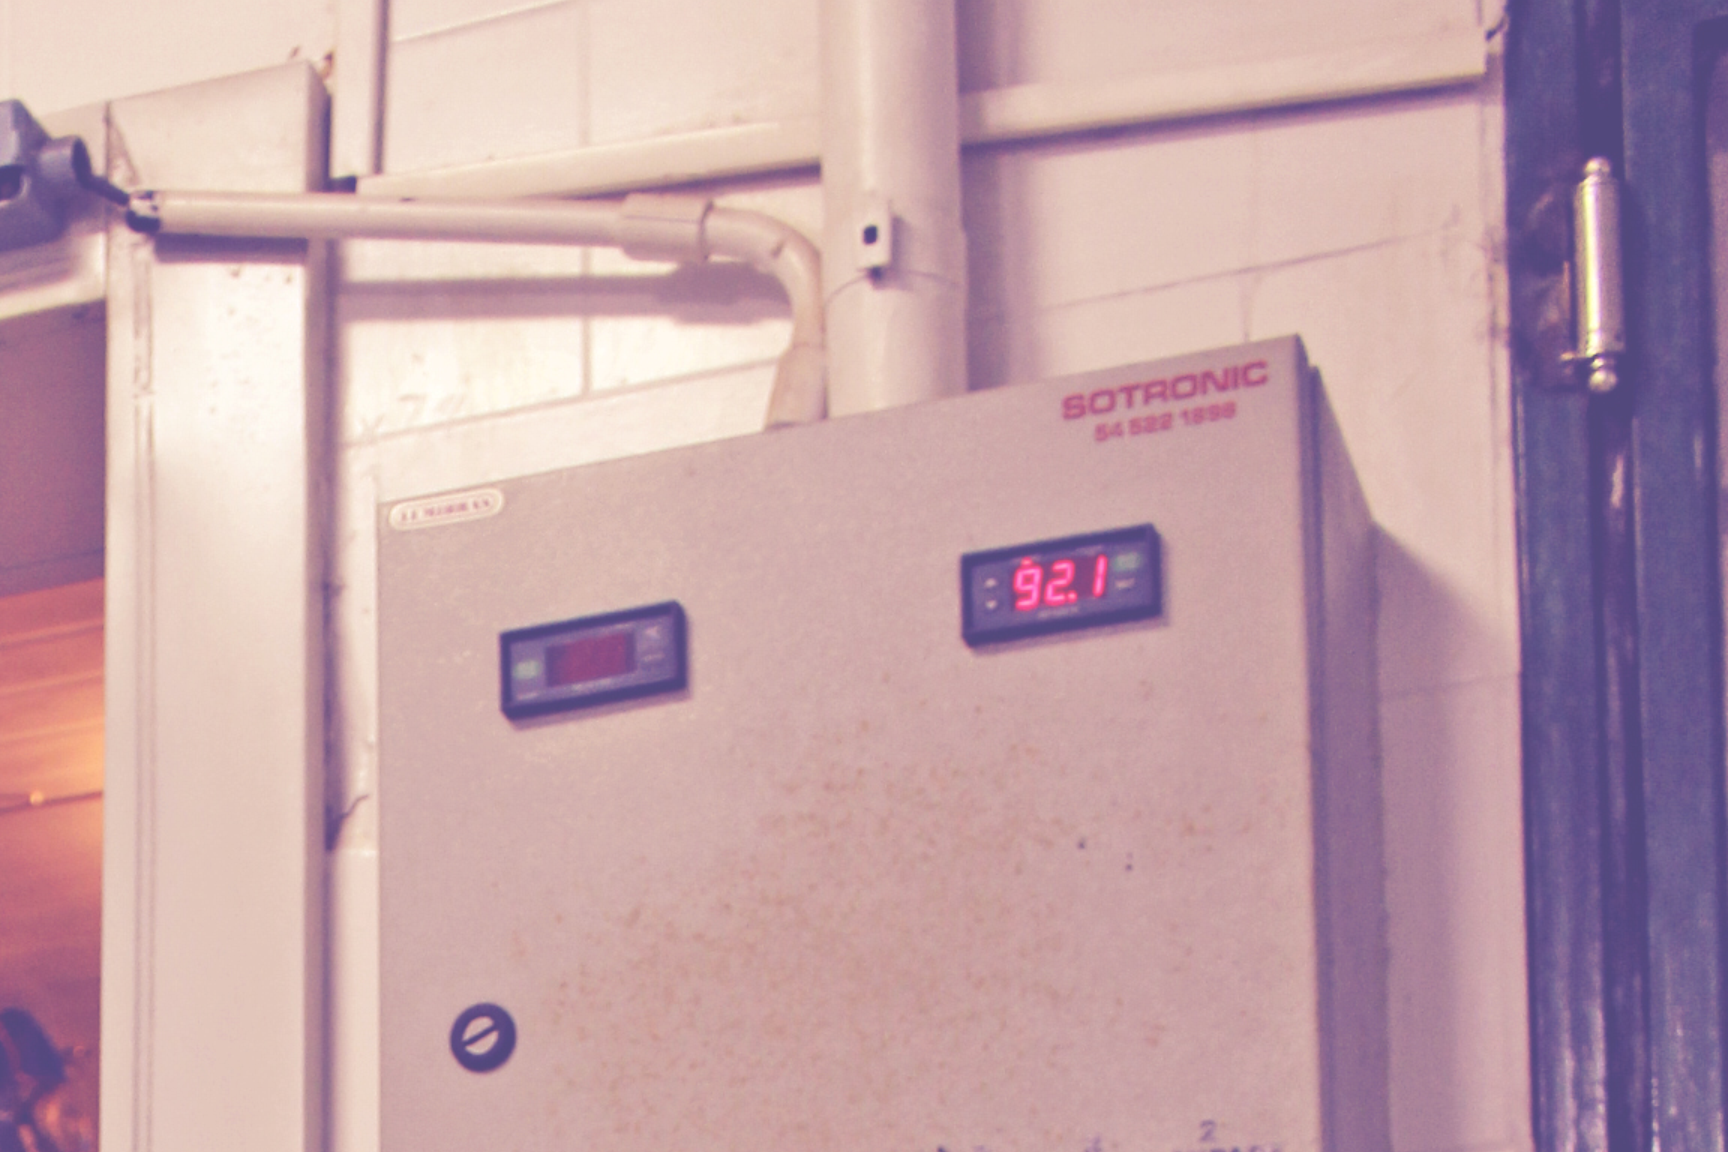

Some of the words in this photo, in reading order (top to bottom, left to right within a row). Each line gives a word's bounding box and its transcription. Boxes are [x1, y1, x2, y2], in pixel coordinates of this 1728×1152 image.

[1062, 361, 1268, 419] SOTRONIC
[1012, 553, 1109, 612] 92.1
[1198, 1119, 1218, 1144] 2
